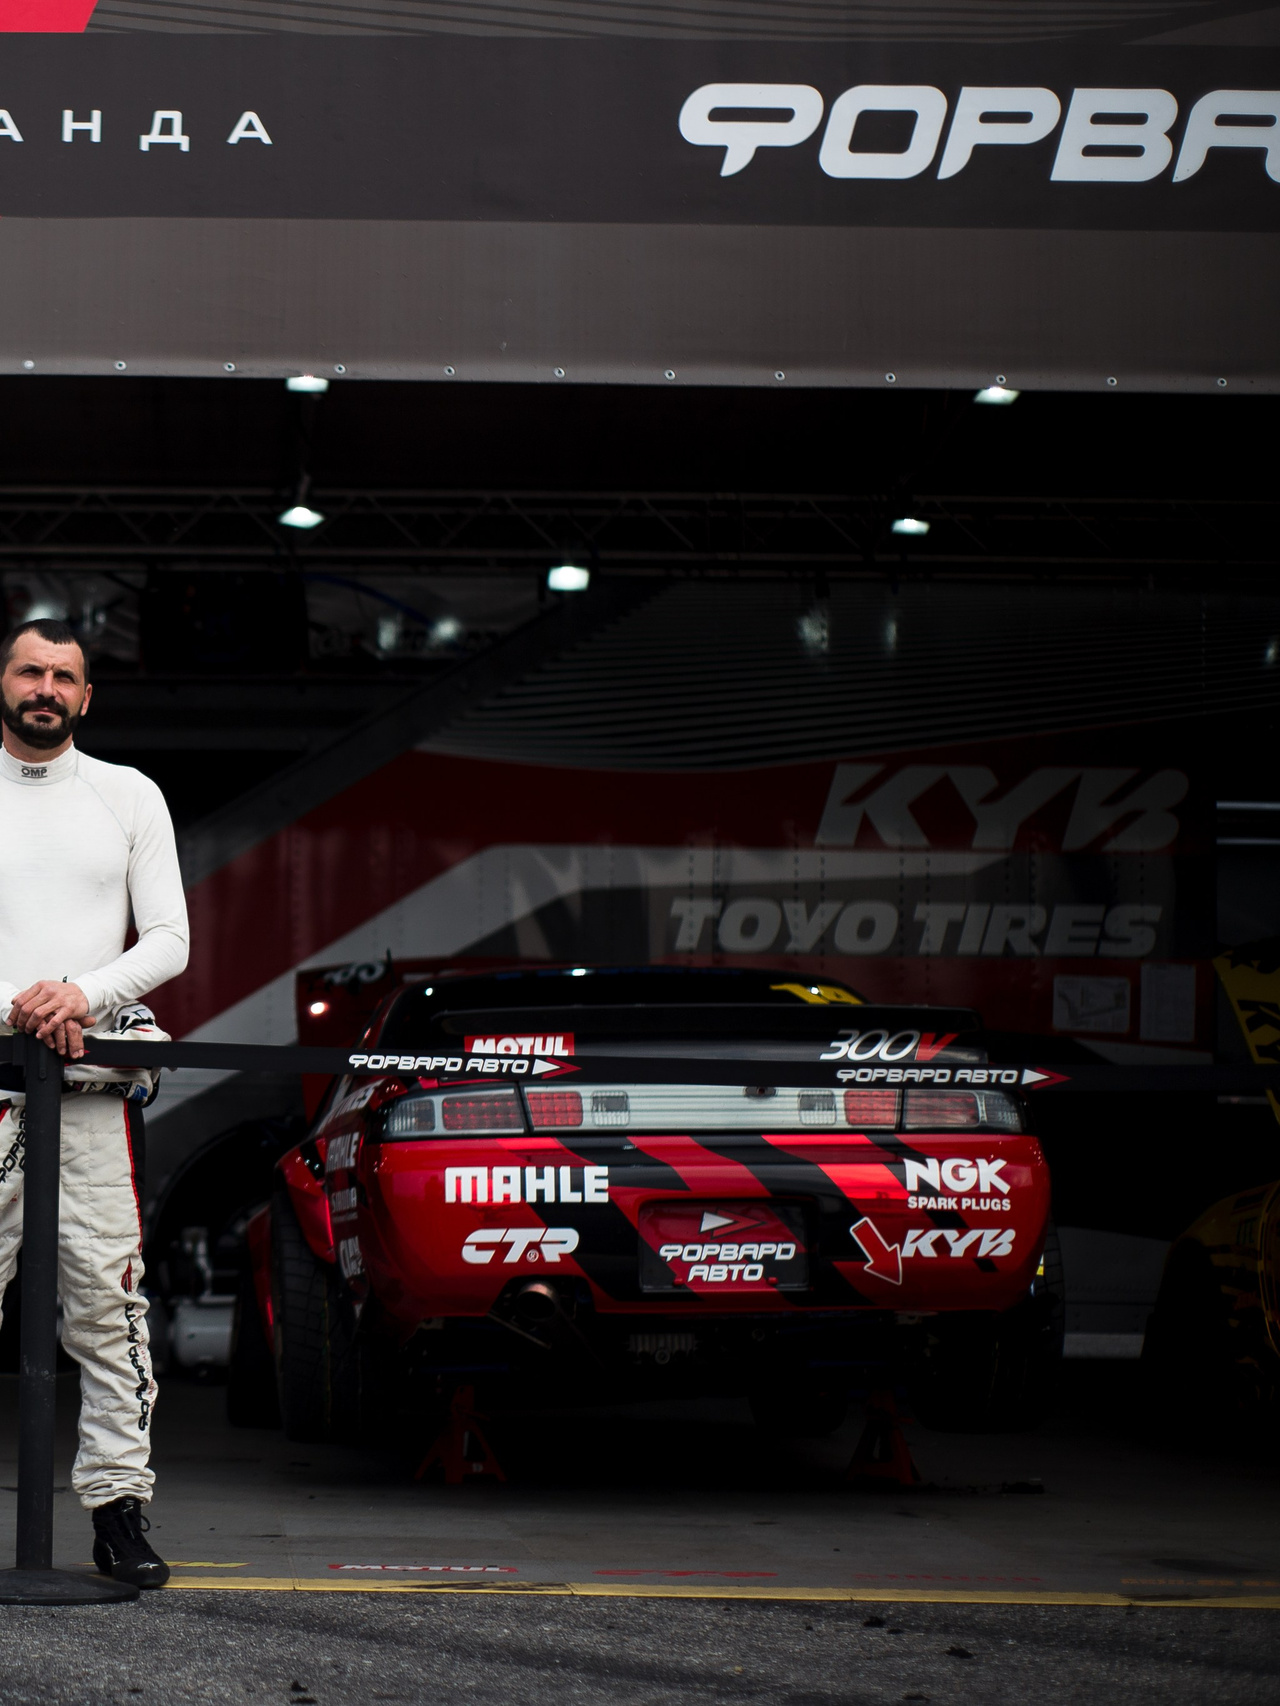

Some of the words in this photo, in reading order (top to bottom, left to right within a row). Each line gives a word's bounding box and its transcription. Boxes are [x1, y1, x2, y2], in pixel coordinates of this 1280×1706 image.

[21, 766, 48, 777] OMP
[814, 761, 1190, 853] KYB
[669, 897, 899, 954] TOYO
[911, 903, 1164, 958] TIRES
[471, 1036, 569, 1056] MOTUL
[820, 1028, 960, 1062] 300V
[444, 1165, 609, 1203] MAHLE
[903, 1158, 1011, 1195] NGK
[907, 1195, 958, 1210] SPARK
[961, 1197, 1011, 1212] PLUGS
[900, 1229, 1016, 1257] KYB
